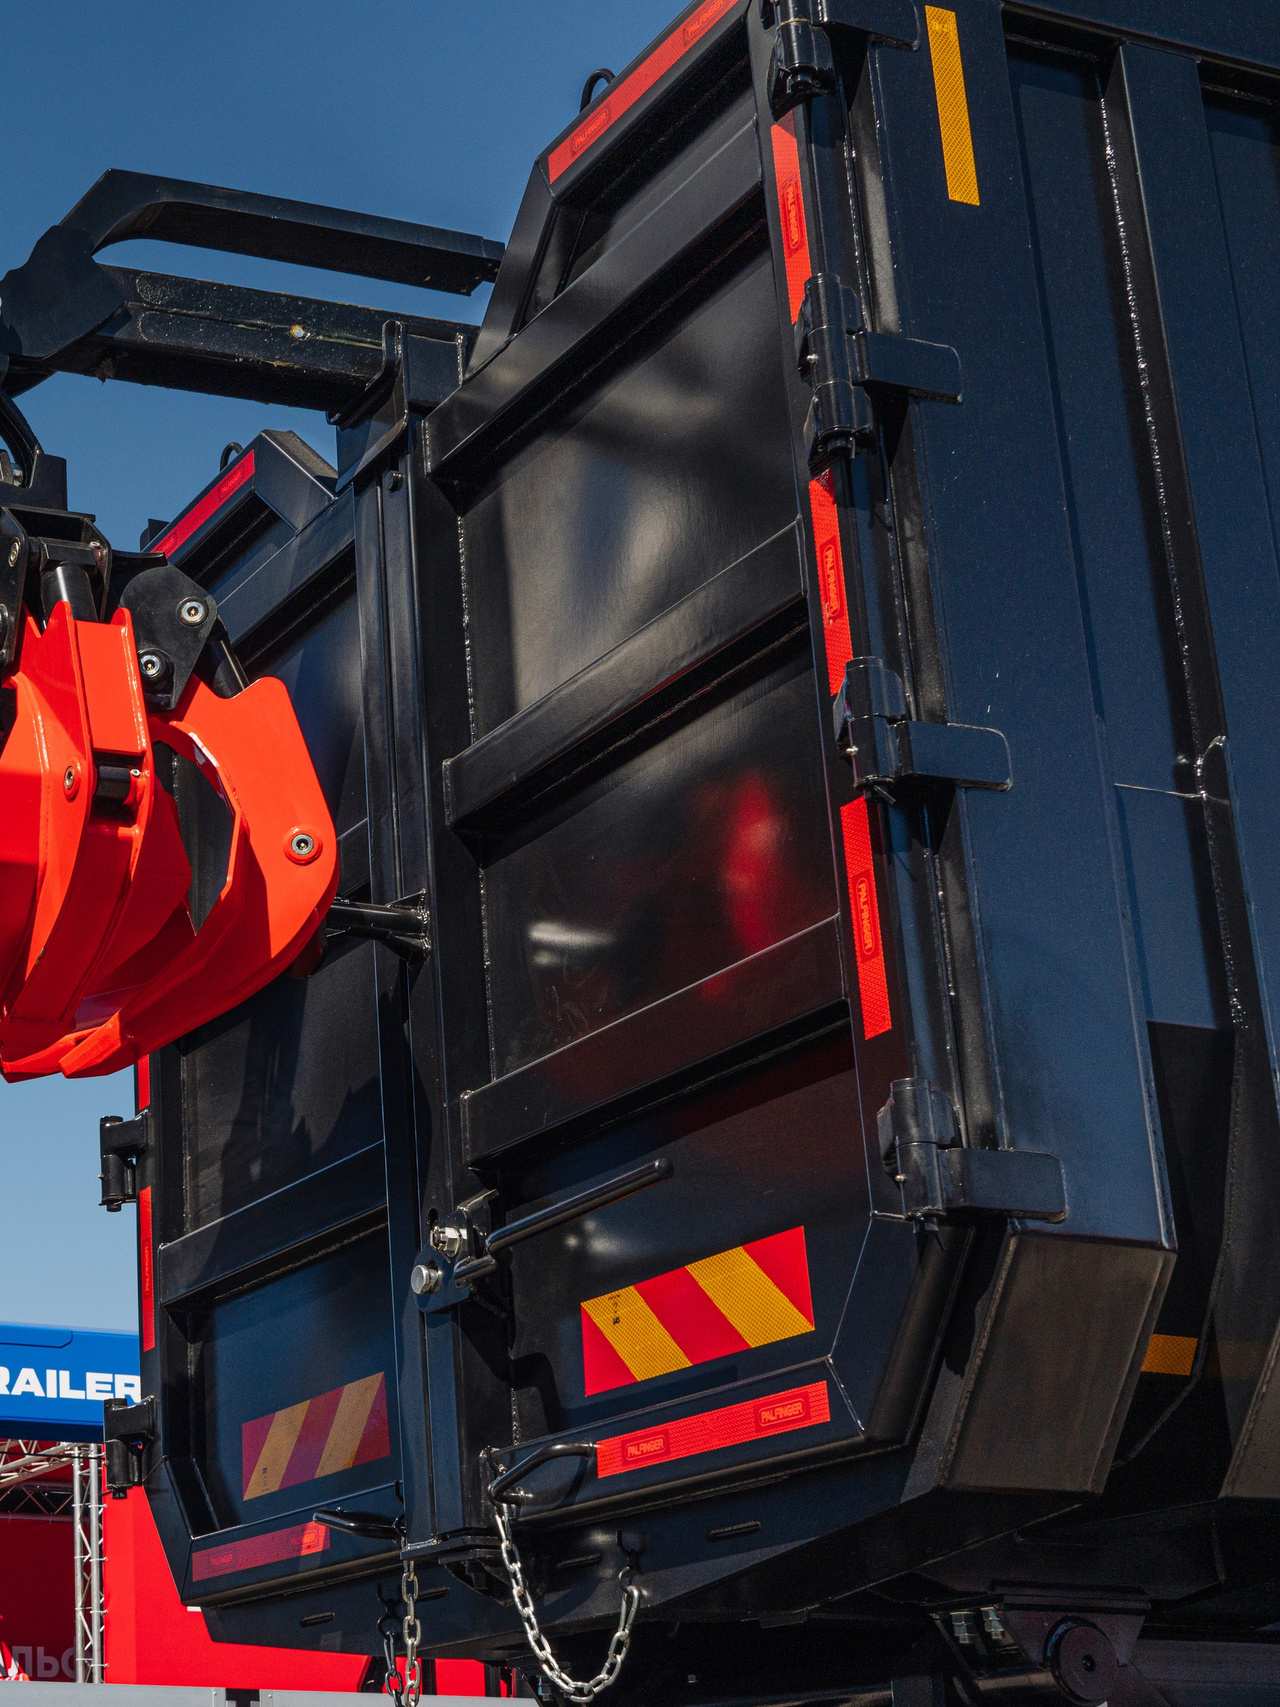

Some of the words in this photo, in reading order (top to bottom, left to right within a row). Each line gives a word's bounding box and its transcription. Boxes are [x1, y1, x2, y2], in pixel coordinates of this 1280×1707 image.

[787, 184, 800, 246] PALFINGER
[825, 549, 838, 613] PALFINGER
[858, 883, 872, 950] PALFINGER
[761, 1402, 803, 1423] PALFINGER
[627, 1438, 664, 1457] PALFINGER
